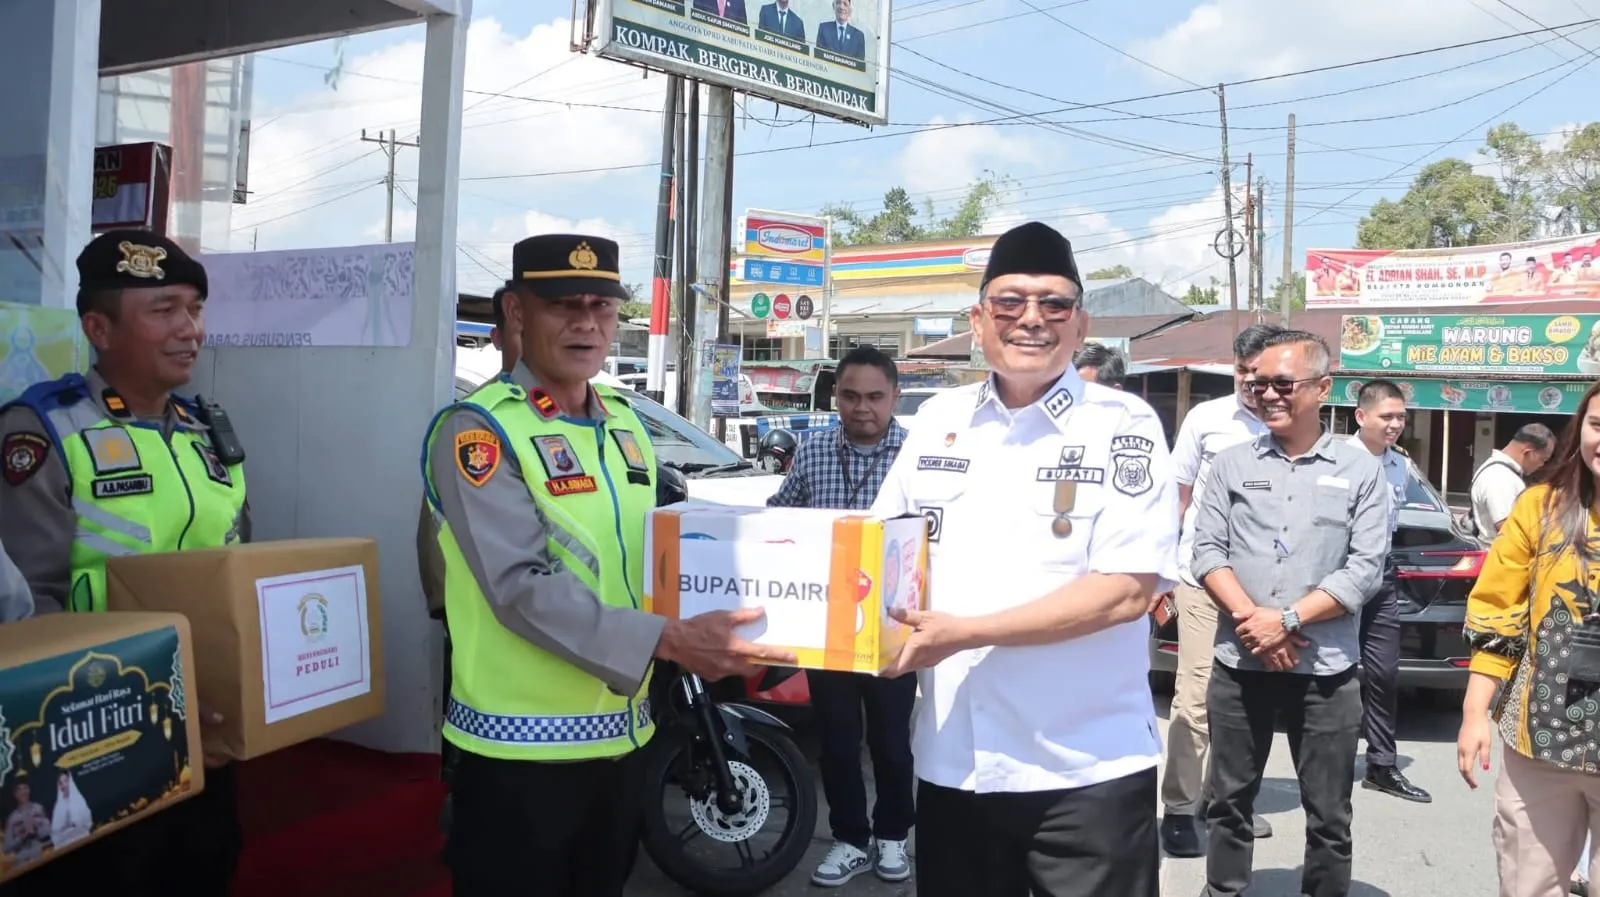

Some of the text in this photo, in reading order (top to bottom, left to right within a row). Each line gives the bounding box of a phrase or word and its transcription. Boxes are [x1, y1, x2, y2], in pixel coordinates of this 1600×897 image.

[615, 25, 694, 62] KOMPAK,
[697, 48, 783, 87] BERGERAK,
[785, 73, 868, 112] BERDAMPAK
[761, 230, 808, 248] Indomaret
[1443, 326, 1532, 344] WARUNG
[1440, 346, 1484, 364] AYAM
[1488, 345, 1504, 364] &
[1507, 346, 1568, 365] BAKSO
[1046, 470, 1095, 480] BUPATI
[678, 574, 760, 597] BUPATI
[296, 655, 339, 676] PEDULI
[61, 697, 94, 713] Selamat
[49, 710, 95, 751] Idul
[100, 695, 142, 735] Fitri
